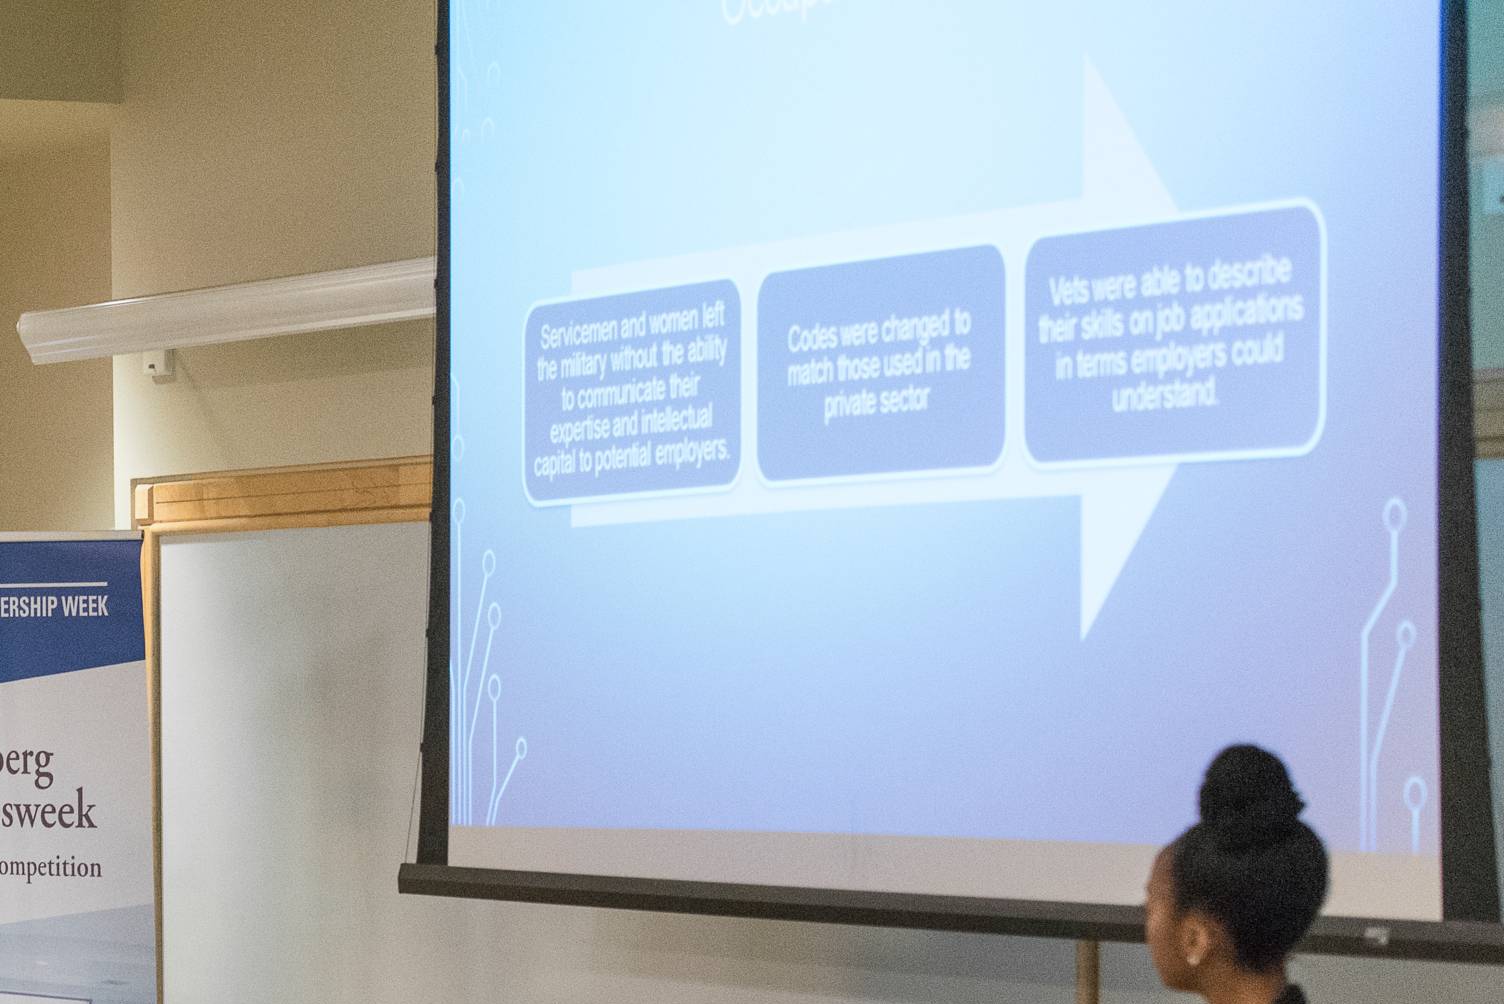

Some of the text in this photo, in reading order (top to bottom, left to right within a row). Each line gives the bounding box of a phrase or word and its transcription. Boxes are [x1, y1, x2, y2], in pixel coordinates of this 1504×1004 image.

[1049, 254, 1293, 306] Vets were able to describe
[540, 300, 725, 350] Servicemen and women left
[788, 307, 971, 352] Codes were changed to
[1038, 293, 1304, 344] their skills on job applications
[537, 334, 727, 382] the military without the ability
[788, 342, 971, 386] match those used in the
[1056, 329, 1284, 381] in terms employers could
[561, 371, 701, 411] to communicate their
[824, 384, 931, 426] private sector
[550, 402, 713, 448] expertise and intellectual
[534, 436, 731, 482] capital to potential employers.
[62, 595, 108, 616] WEEK
